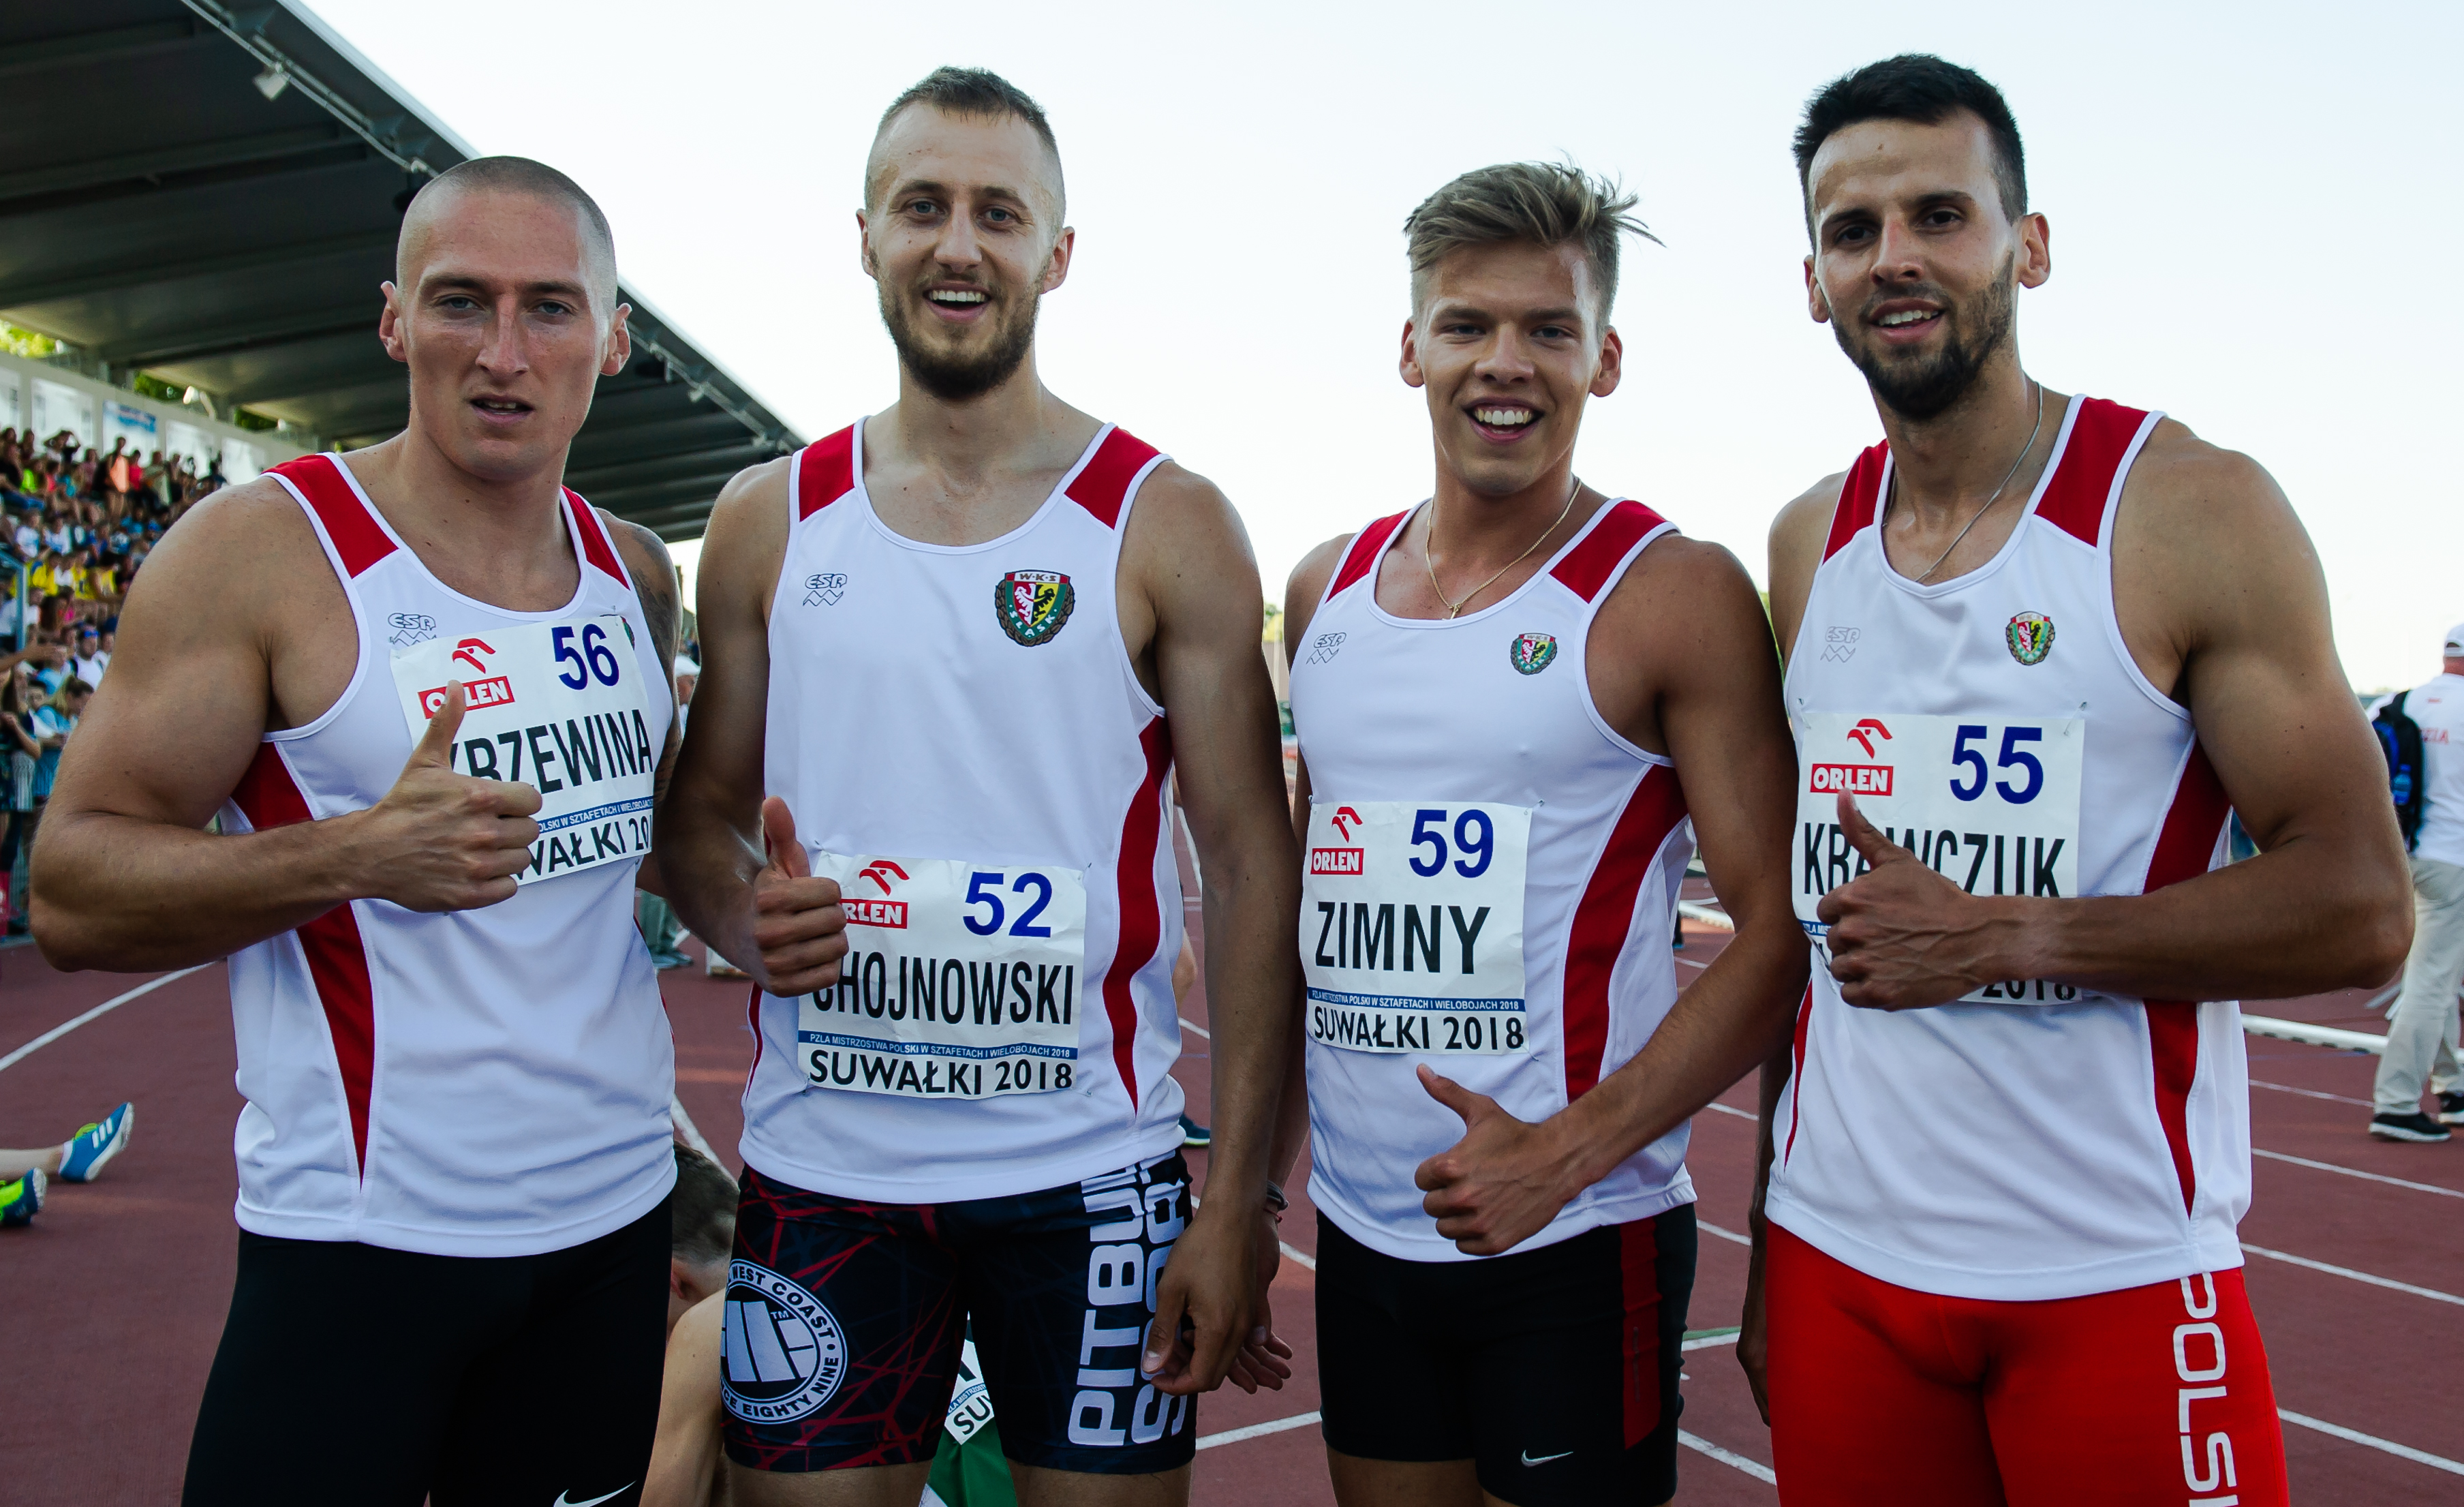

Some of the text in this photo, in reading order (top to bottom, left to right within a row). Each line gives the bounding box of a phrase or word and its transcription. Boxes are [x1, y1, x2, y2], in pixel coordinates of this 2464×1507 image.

[551, 623, 619, 690] 56
[426, 680, 510, 713] OLEN
[450, 709, 653, 795] RZEWINA
[1813, 766, 1889, 792] ORLEN
[1950, 725, 2044, 804] 55
[538, 820, 560, 832] OLSKI
[561, 818, 569, 826] W
[570, 805, 617, 824] SZTAFETACH
[1408, 809, 1494, 878] 59
[517, 821, 627, 880] WAŁKI
[1313, 851, 1360, 872] ORLEN
[1804, 822, 2065, 898] KRCZUK
[842, 902, 902, 925] RLEN
[963, 871, 1053, 938] 52
[1315, 900, 1492, 975] ZIMNY
[1314, 1005, 1524, 1050] SUWAŁKI 2018
[1349, 995, 1370, 1005] POLSKI
[1379, 998, 1429, 1009] SZTAFETACH
[1435, 1000, 1498, 1009] WIELOBOJACH
[1500, 1001, 1519, 1009] 2018
[810, 1033, 831, 1044] PZLA
[832, 1036, 888, 1050] MISTRZOSTWA
[889, 1044, 919, 1054] POLSKI
[921, 1044, 929, 1053] W
[931, 1046, 983, 1058] SZTAFETACH
[989, 1045, 1049, 1058] WIELOBOJACH
[1051, 1048, 1070, 1057] 2018
[810, 1049, 1073, 1095] SUWAŁKI 2018
[732, 1266, 836, 1339] WEST COAST
[770, 1310, 789, 1320] TM
[1068, 1163, 1144, 1446] PITBUL
[743, 1393, 813, 1418] EIGHTY
[810, 1357, 839, 1395] NINE
